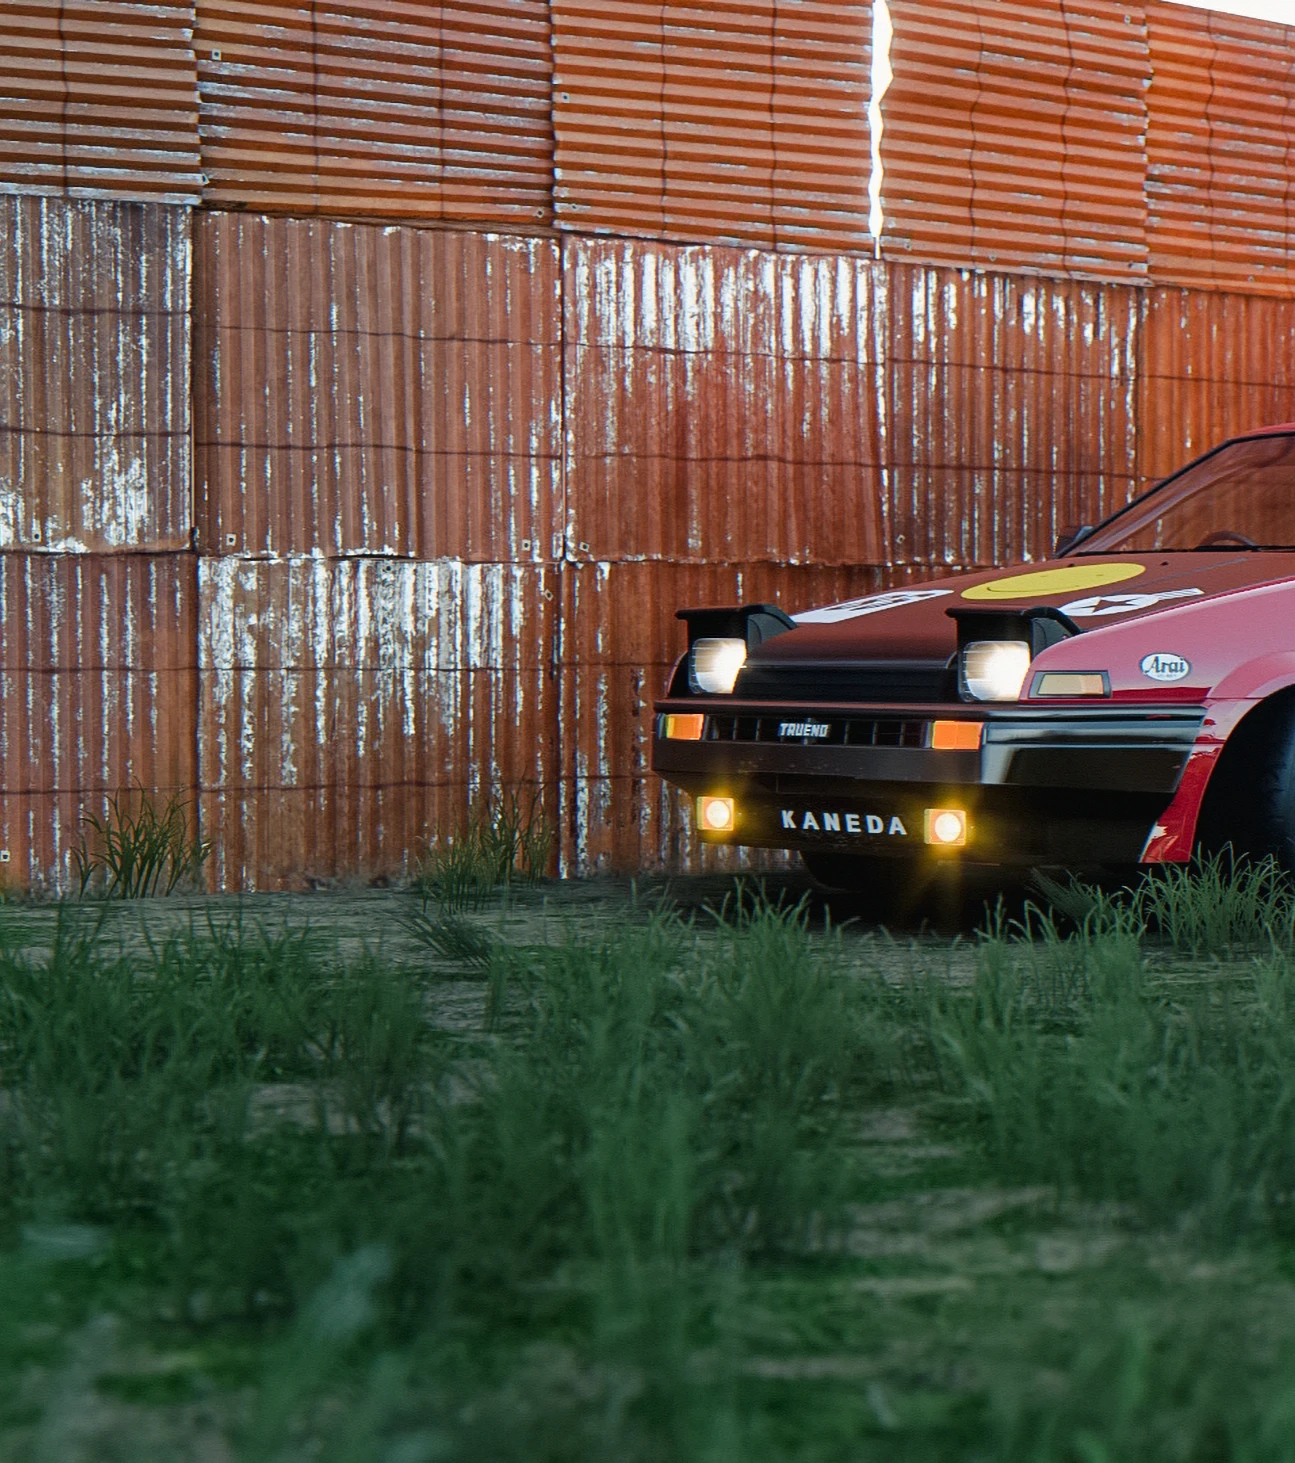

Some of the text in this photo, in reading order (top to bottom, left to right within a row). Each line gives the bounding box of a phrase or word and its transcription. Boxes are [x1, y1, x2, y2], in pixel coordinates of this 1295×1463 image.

[1145, 656, 1185, 673] Arai
[779, 722, 829, 737] TRUENO
[781, 810, 907, 835] KANEDA
